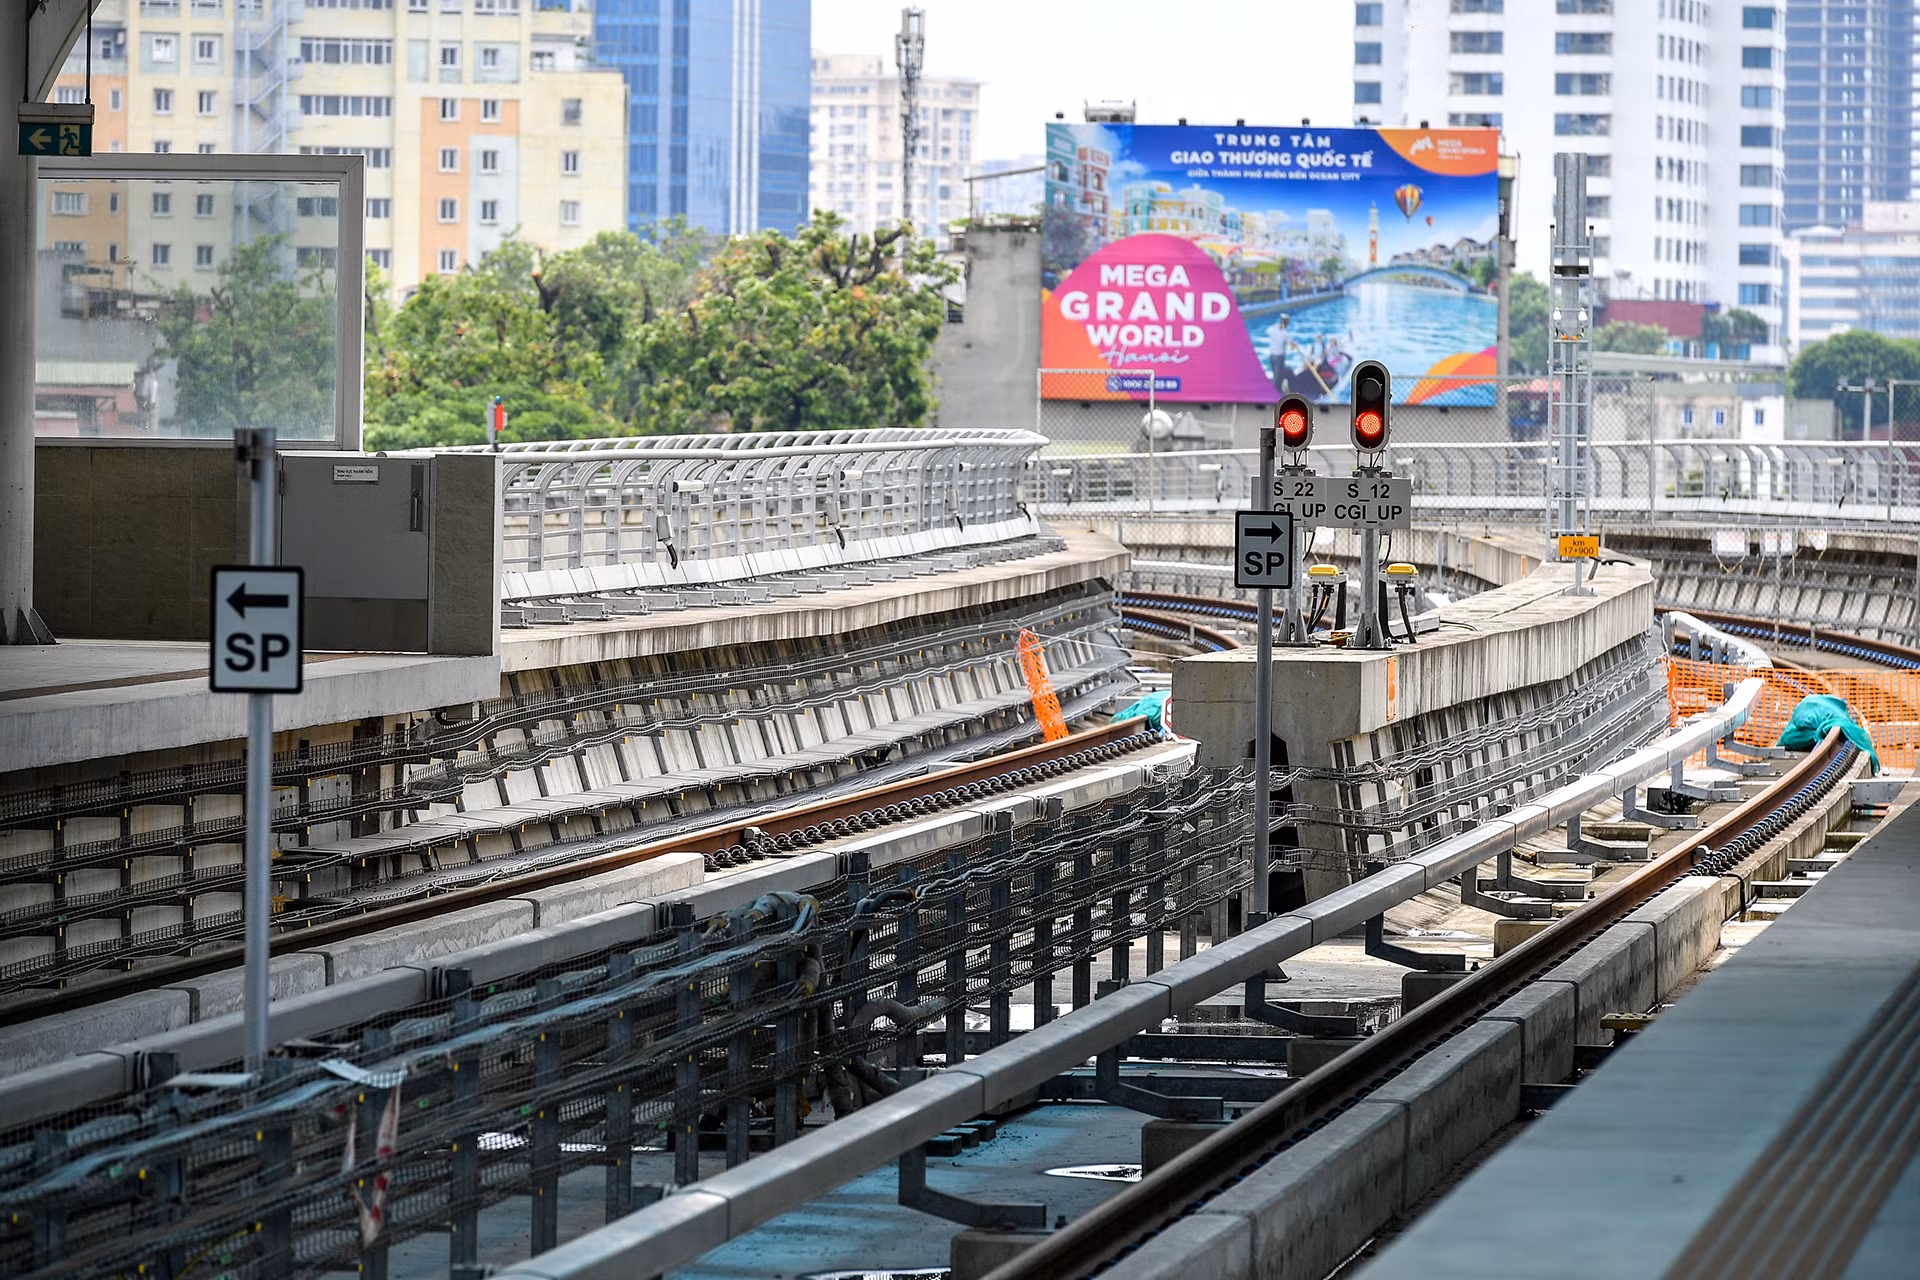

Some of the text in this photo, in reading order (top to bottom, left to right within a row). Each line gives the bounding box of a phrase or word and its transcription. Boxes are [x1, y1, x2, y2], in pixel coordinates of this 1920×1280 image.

[1214, 132, 1331, 148] TRUNG TÂM
[1170, 149, 1374, 169] GIAO THƯƠNG QUỐC TẾ
[1100, 264, 1190, 287] MEGA
[1060, 290, 1231, 321] GRAND
[1086, 324, 1205, 347] WORLD
[1274, 482, 1314, 500] S_22
[1347, 484, 1390, 502] S_12
[1274, 503, 1326, 521] GI_UP
[1334, 505, 1402, 523] CGI_UP
[1564, 547, 1594, 555] 17+900
[1244, 552, 1285, 576] SP
[225, 632, 291, 672] SP
